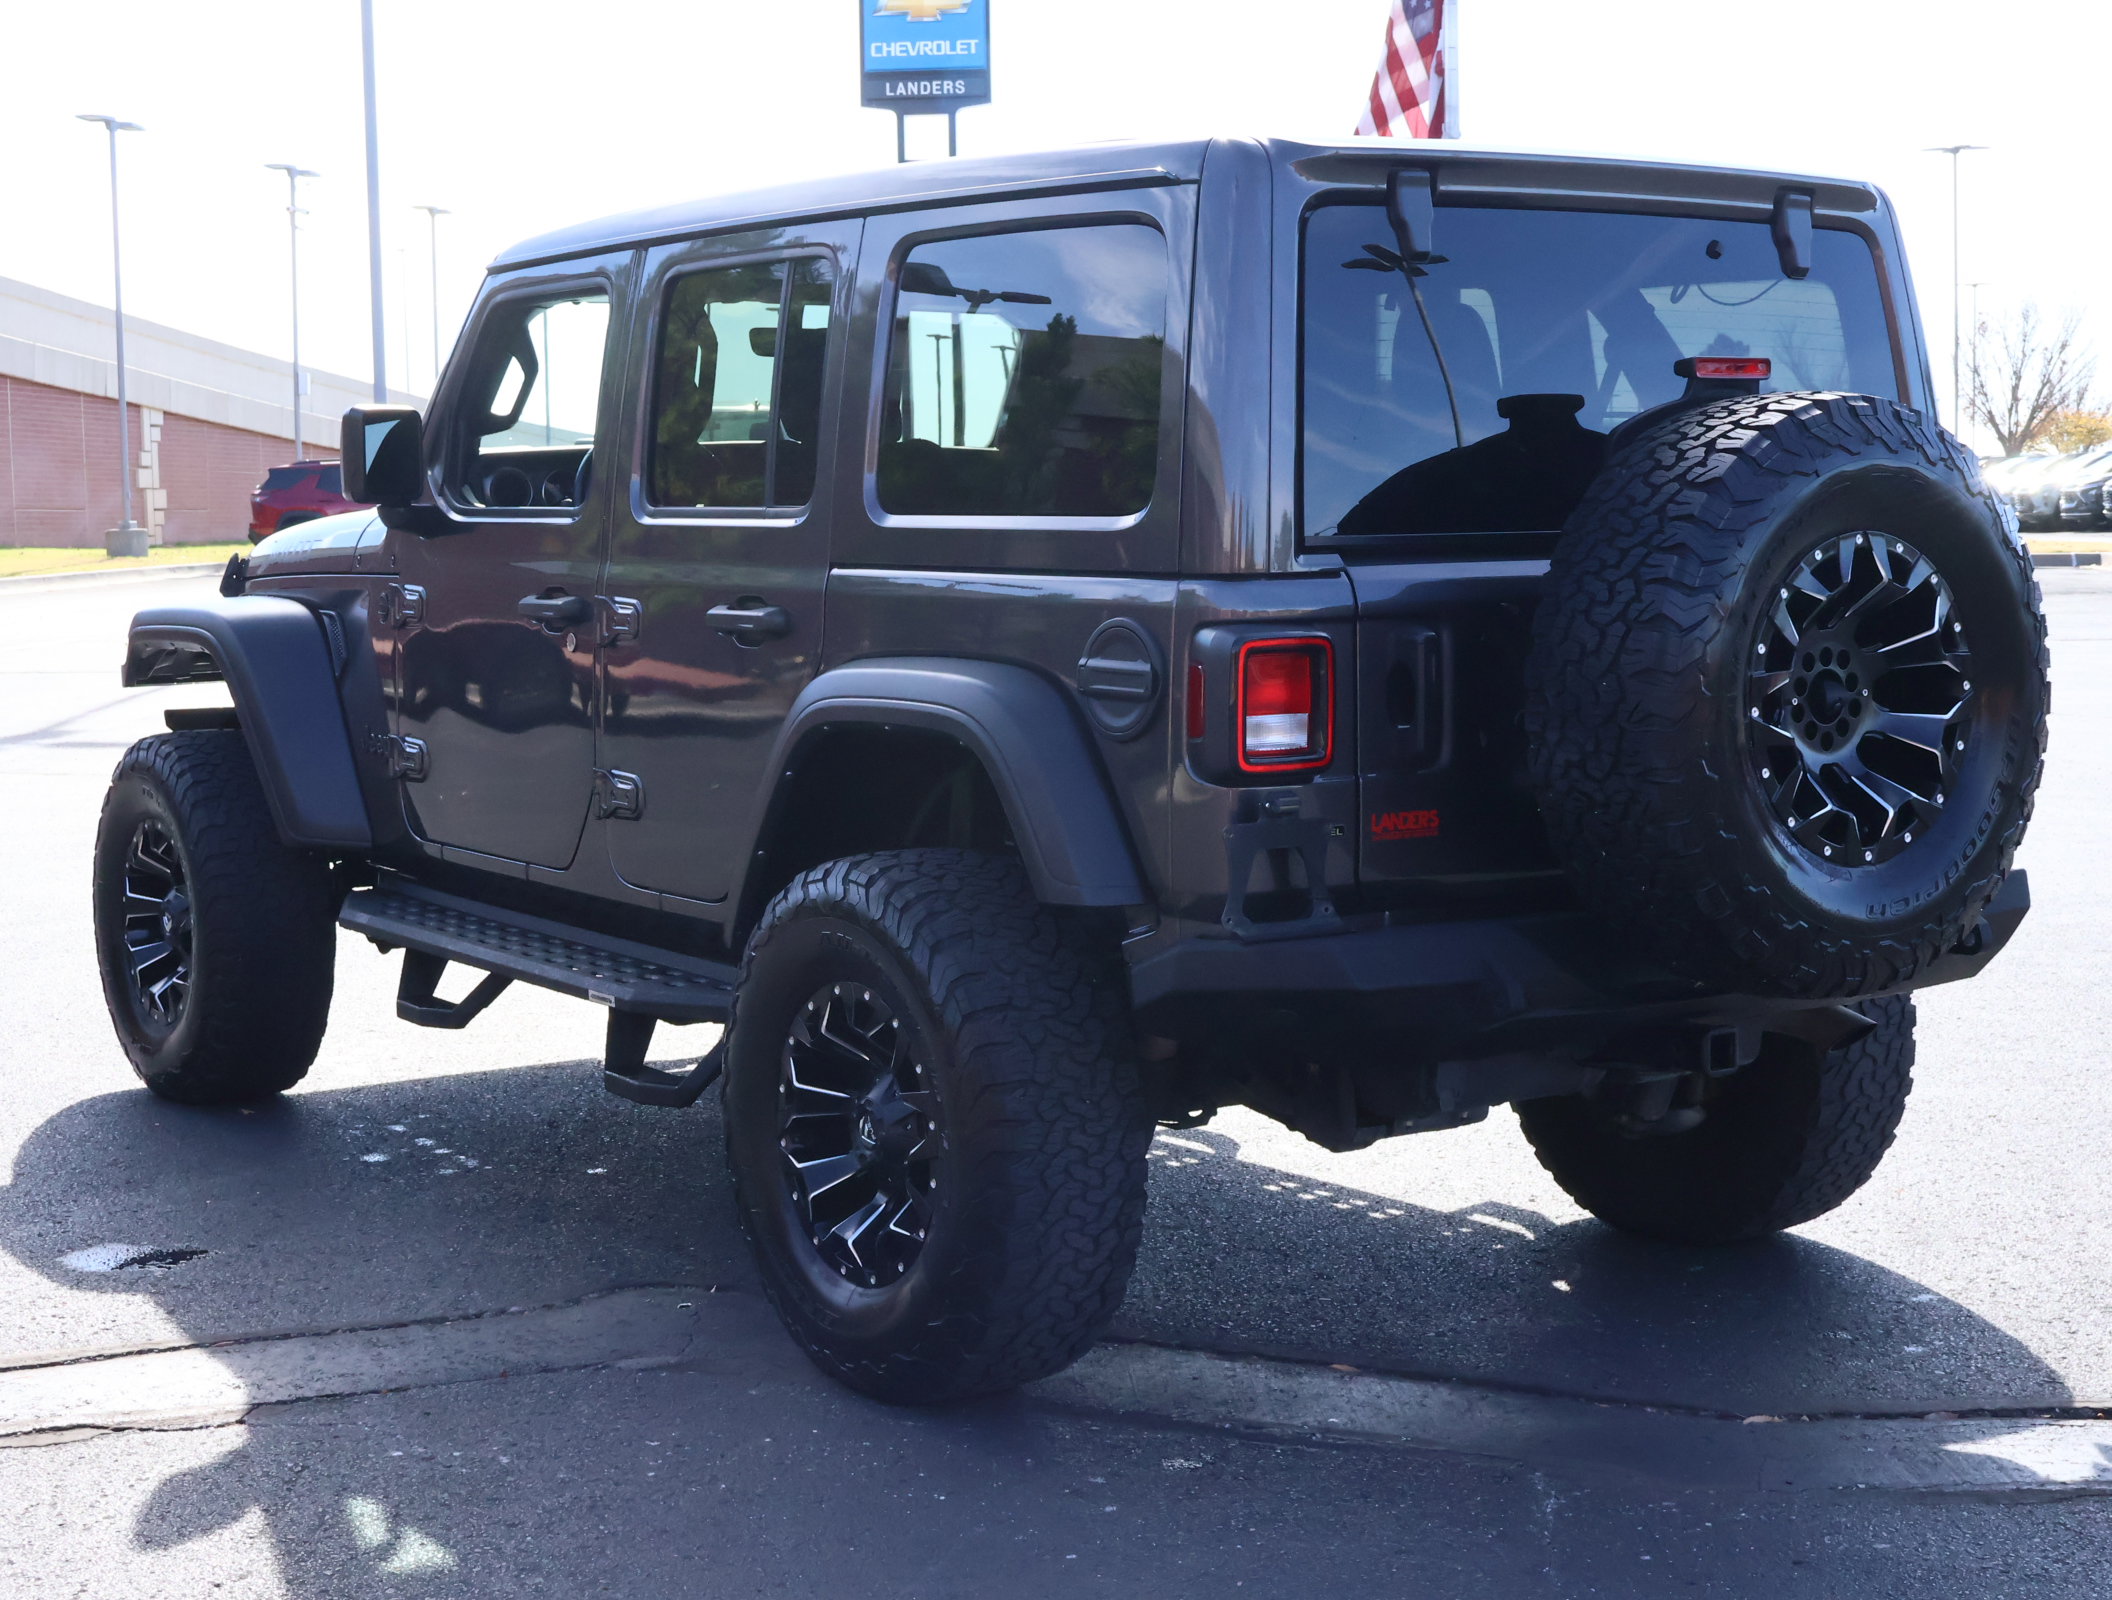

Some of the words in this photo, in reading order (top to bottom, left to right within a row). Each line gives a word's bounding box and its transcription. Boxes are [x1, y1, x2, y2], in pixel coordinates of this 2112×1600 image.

[870, 39, 979, 57] CHEVROLET
[885, 80, 966, 96] LANDERS
[1371, 809, 1441, 834] LANDERS
